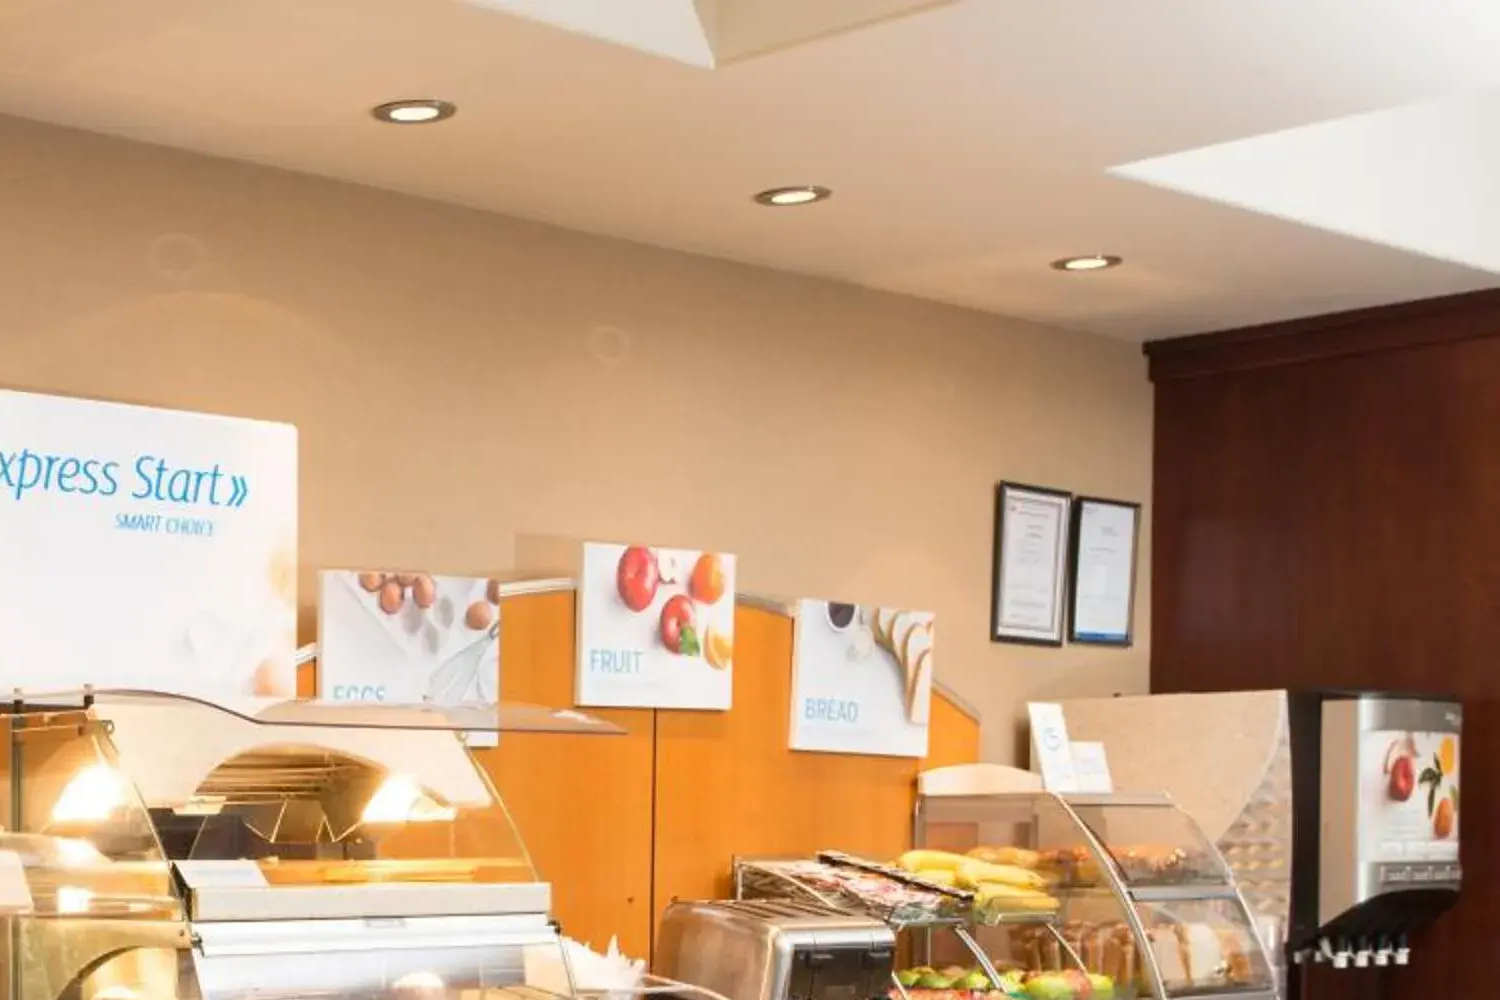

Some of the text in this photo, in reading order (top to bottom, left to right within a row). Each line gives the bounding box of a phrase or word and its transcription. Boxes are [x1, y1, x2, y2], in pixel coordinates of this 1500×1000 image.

[114, 513, 161, 532] SMART
[589, 648, 645, 674] FRUIT
[805, 697, 859, 723] BREAD
